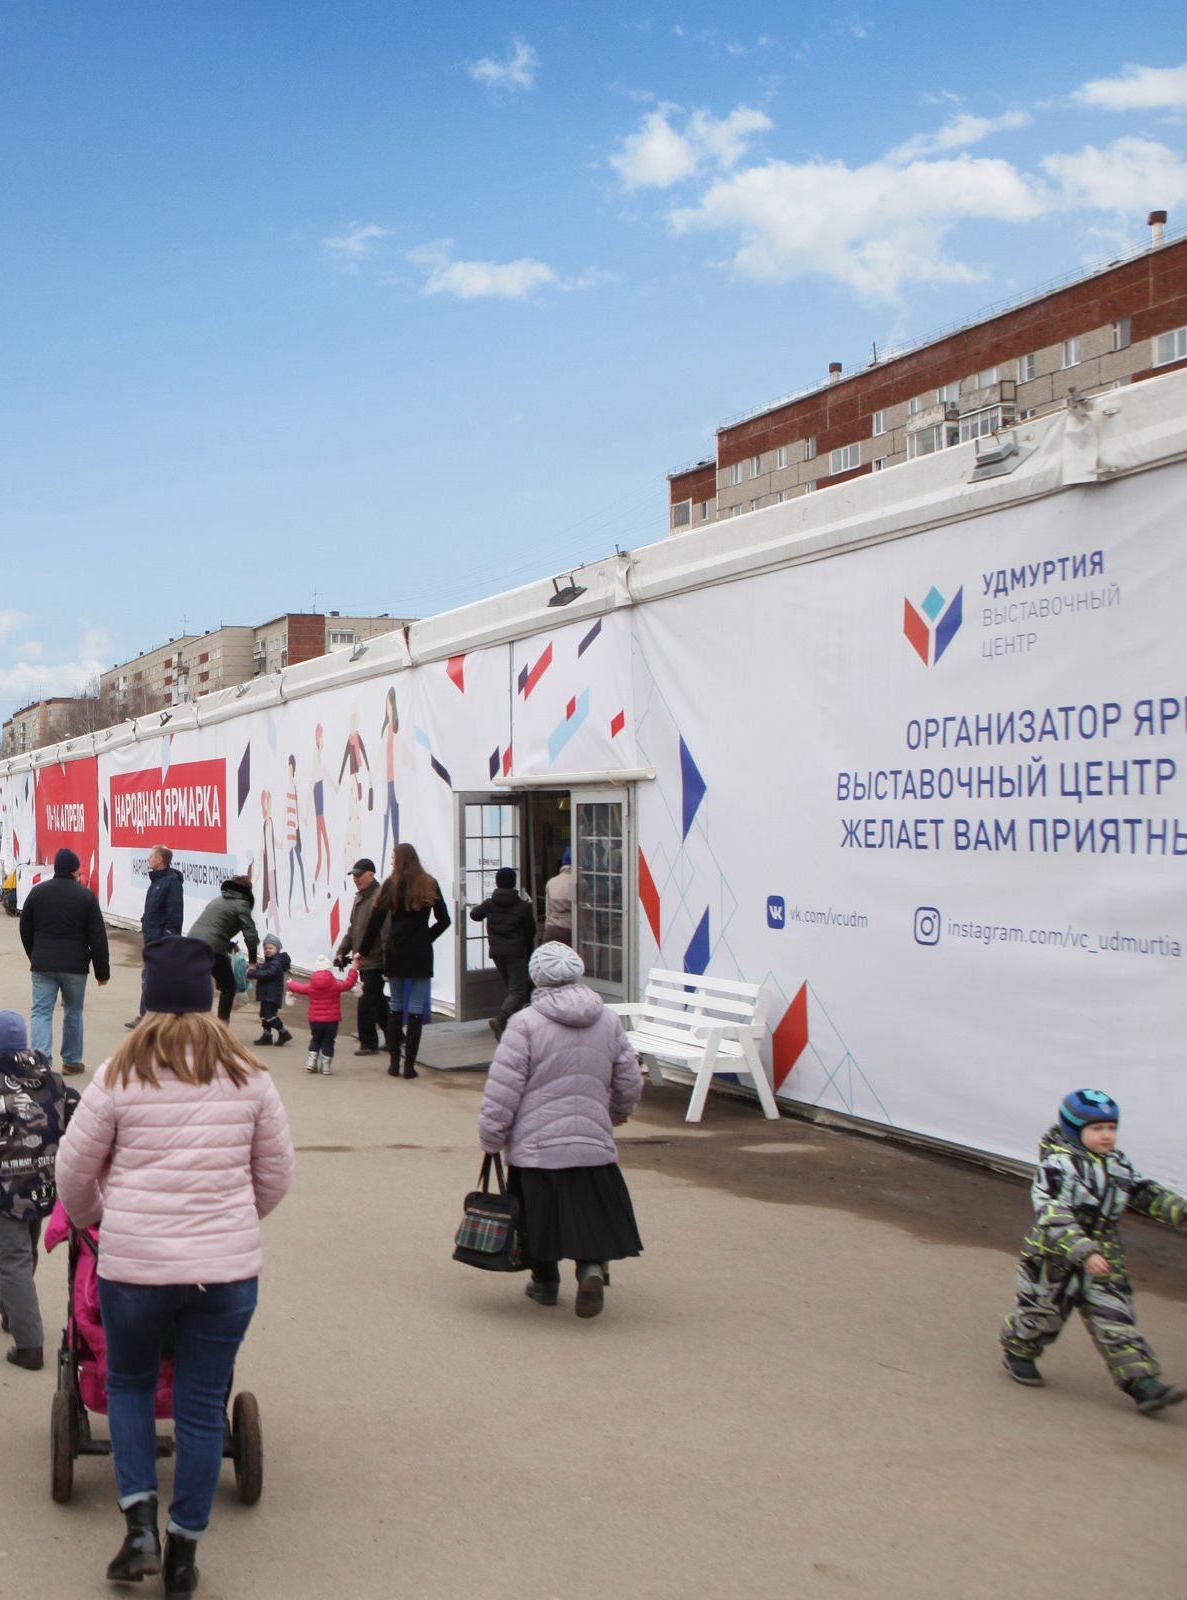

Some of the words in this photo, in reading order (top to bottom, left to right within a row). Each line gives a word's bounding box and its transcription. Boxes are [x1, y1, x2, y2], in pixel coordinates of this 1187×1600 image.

[982, 550, 1104, 599] УДМУРТИЯ
[982, 582, 1121, 627] ВЫСТАВОЧНЫЙ
[981, 633, 1038, 661] ЦЕНТР
[906, 702, 1122, 750] ОРГАНИЗАТОР
[1133, 696, 1187, 736] ЯР
[836, 755, 1047, 801] ВЫСТАВОЧНЫЙ
[1060, 758, 1177, 803] ЦЕНТР
[60, 803, 85, 832] АПРЕЛЯ
[114, 789, 162, 834] НАРОДНАЯ
[163, 784, 221, 828] ЯРМАРКА
[840, 818, 945, 850] ЖЕЛАЕТ
[954, 818, 1017, 852] ВАМ
[182, 862, 208, 886] НАРОДОВ
[789, 905, 869, 928] vk.com/vcudm
[947, 918, 1182, 957] instagram.com/vc_udmurtia
